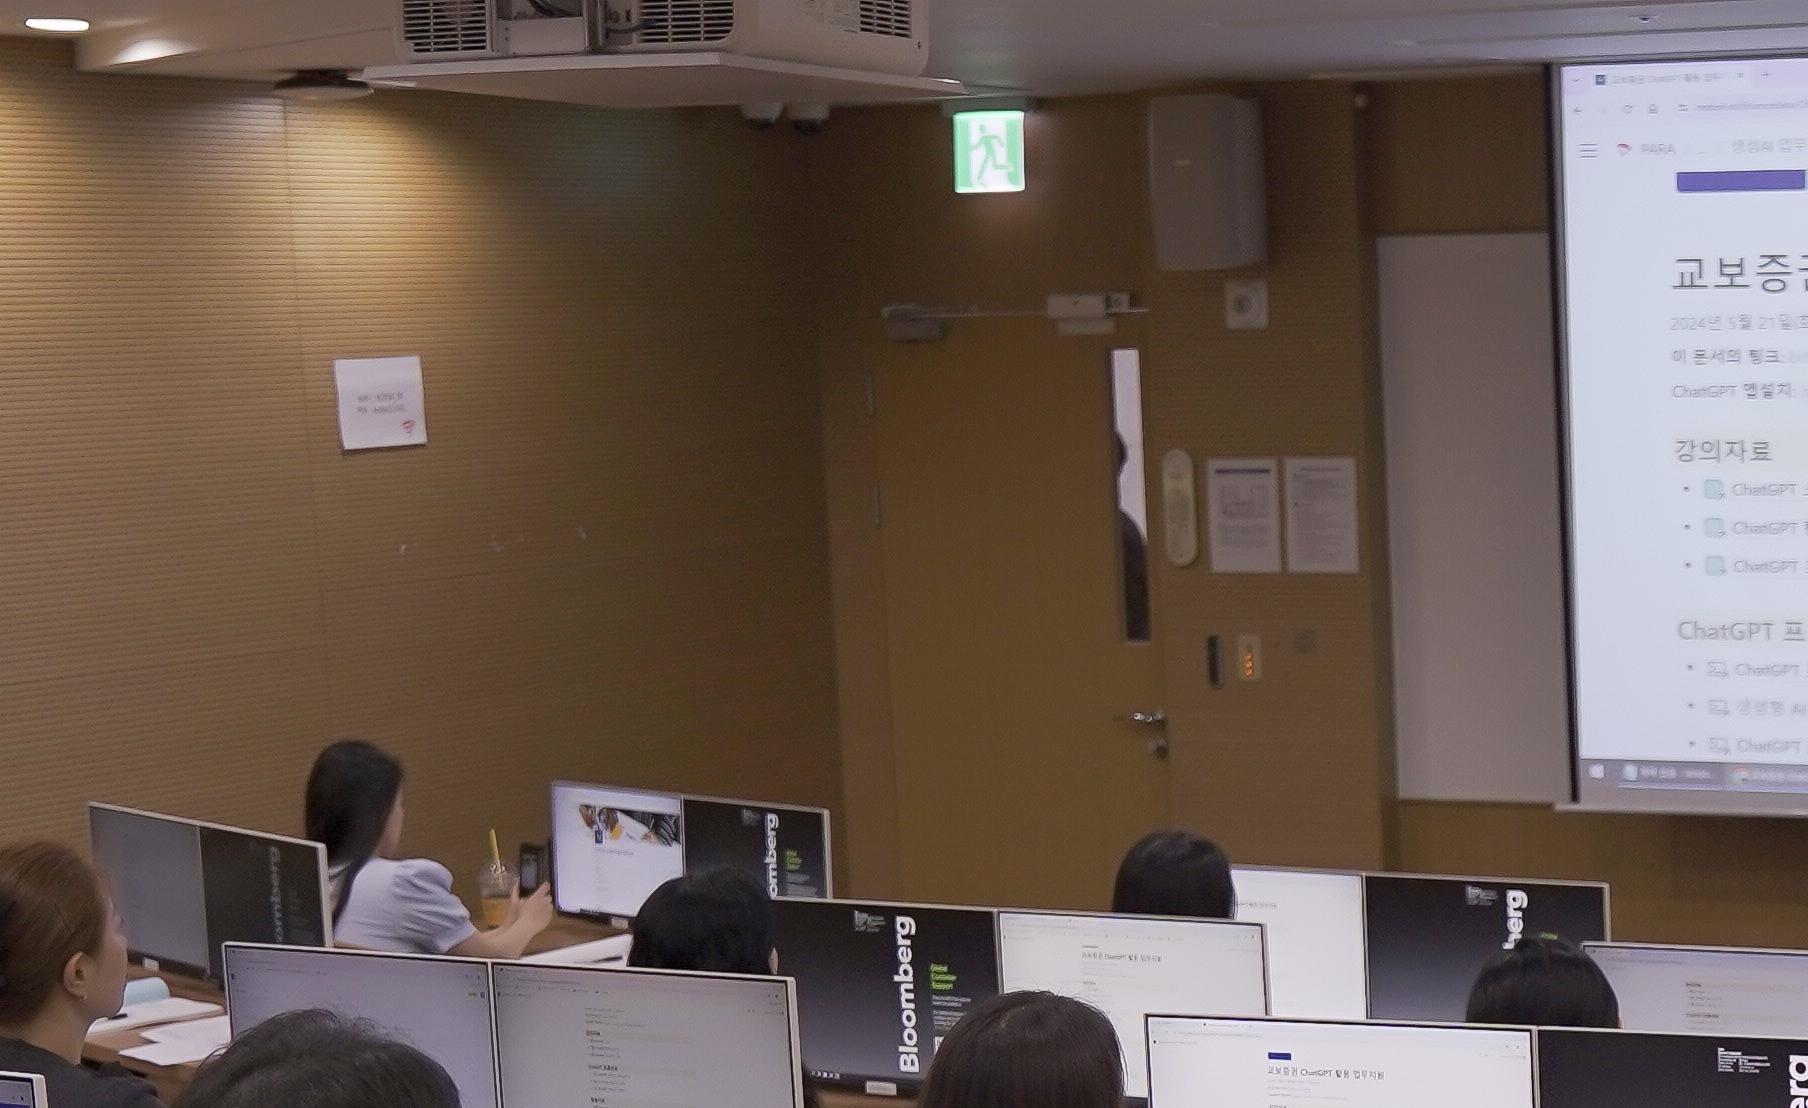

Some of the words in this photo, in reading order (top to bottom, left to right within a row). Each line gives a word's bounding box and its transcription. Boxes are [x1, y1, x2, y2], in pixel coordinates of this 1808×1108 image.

[1671, 314, 1722, 331] 2024년
[1728, 313, 1753, 331] 5월
[1672, 349, 1686, 363] 이
[1693, 349, 1742, 365] 문서의
[1672, 385, 1737, 399] ChatGPT
[1676, 440, 1773, 464] 강의자료
[1732, 483, 1798, 497] ChatGPT
[1732, 521, 1798, 535] ChatGPT
[1733, 560, 1798, 574] ChatGPT
[1678, 621, 1774, 641] ChatGPT
[1736, 664, 1800, 677] ChatGPT
[1737, 739, 1801, 753] ChatGPT
[893, 914, 920, 1073] Bloomberg
